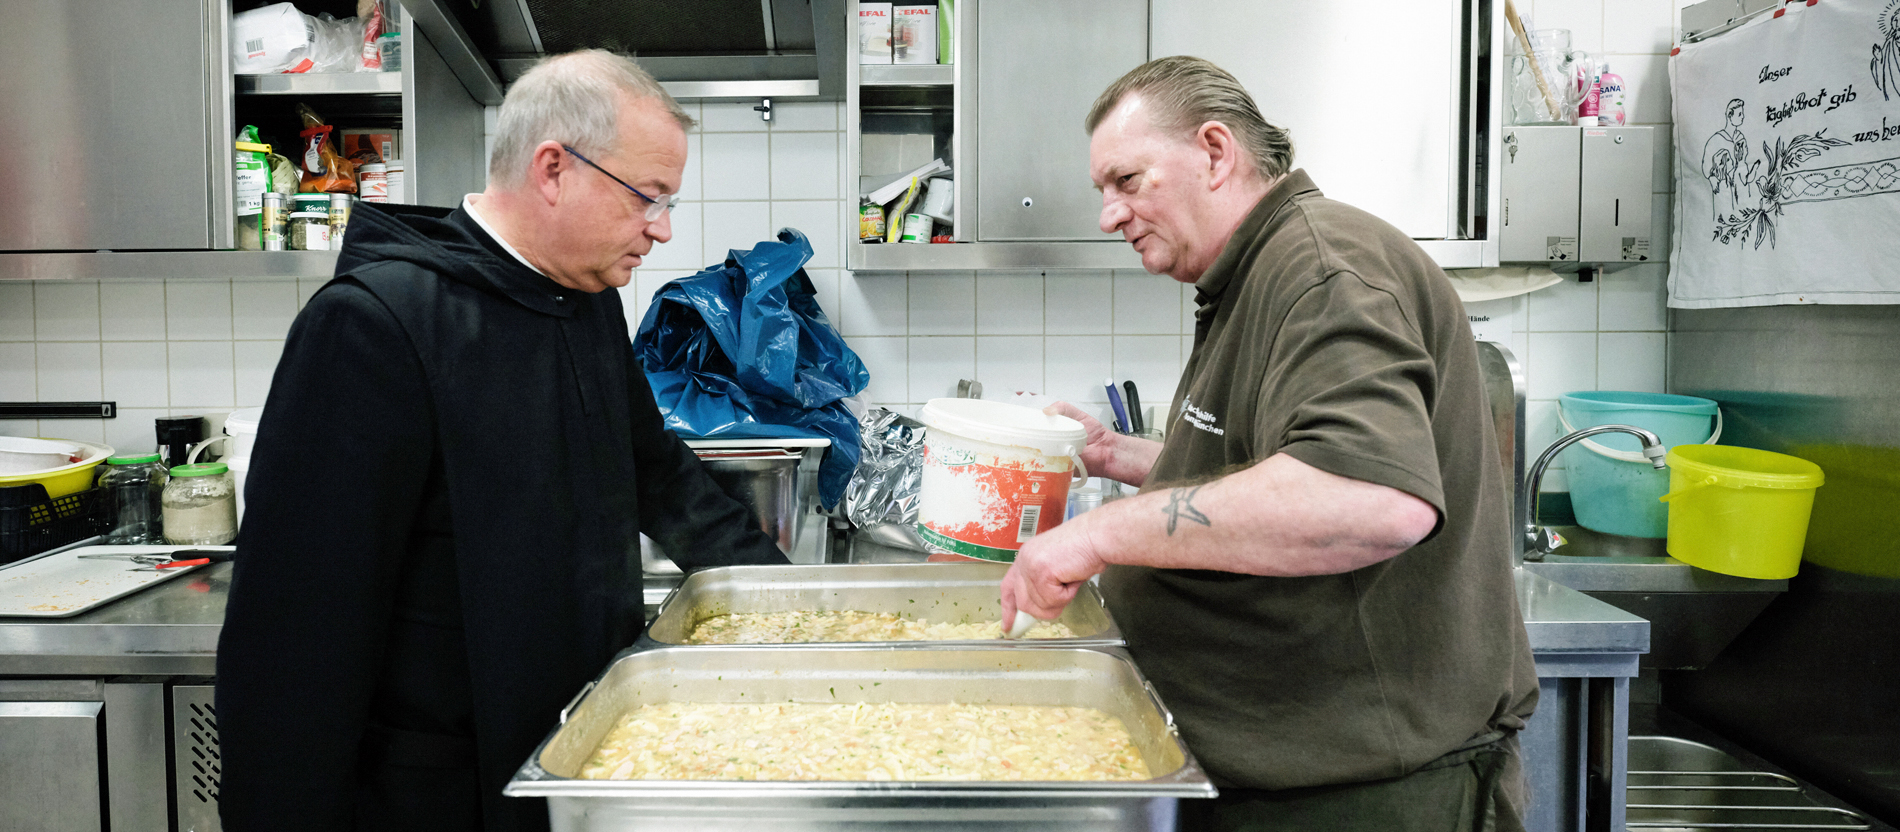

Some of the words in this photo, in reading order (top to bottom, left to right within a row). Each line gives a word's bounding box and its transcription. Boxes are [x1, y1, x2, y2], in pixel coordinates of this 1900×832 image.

[1600, 85, 1621, 94] SANA
[1823, 84, 1857, 114] gib
[1852, 129, 1880, 143] uns
[305, 204, 327, 212] Knorr
